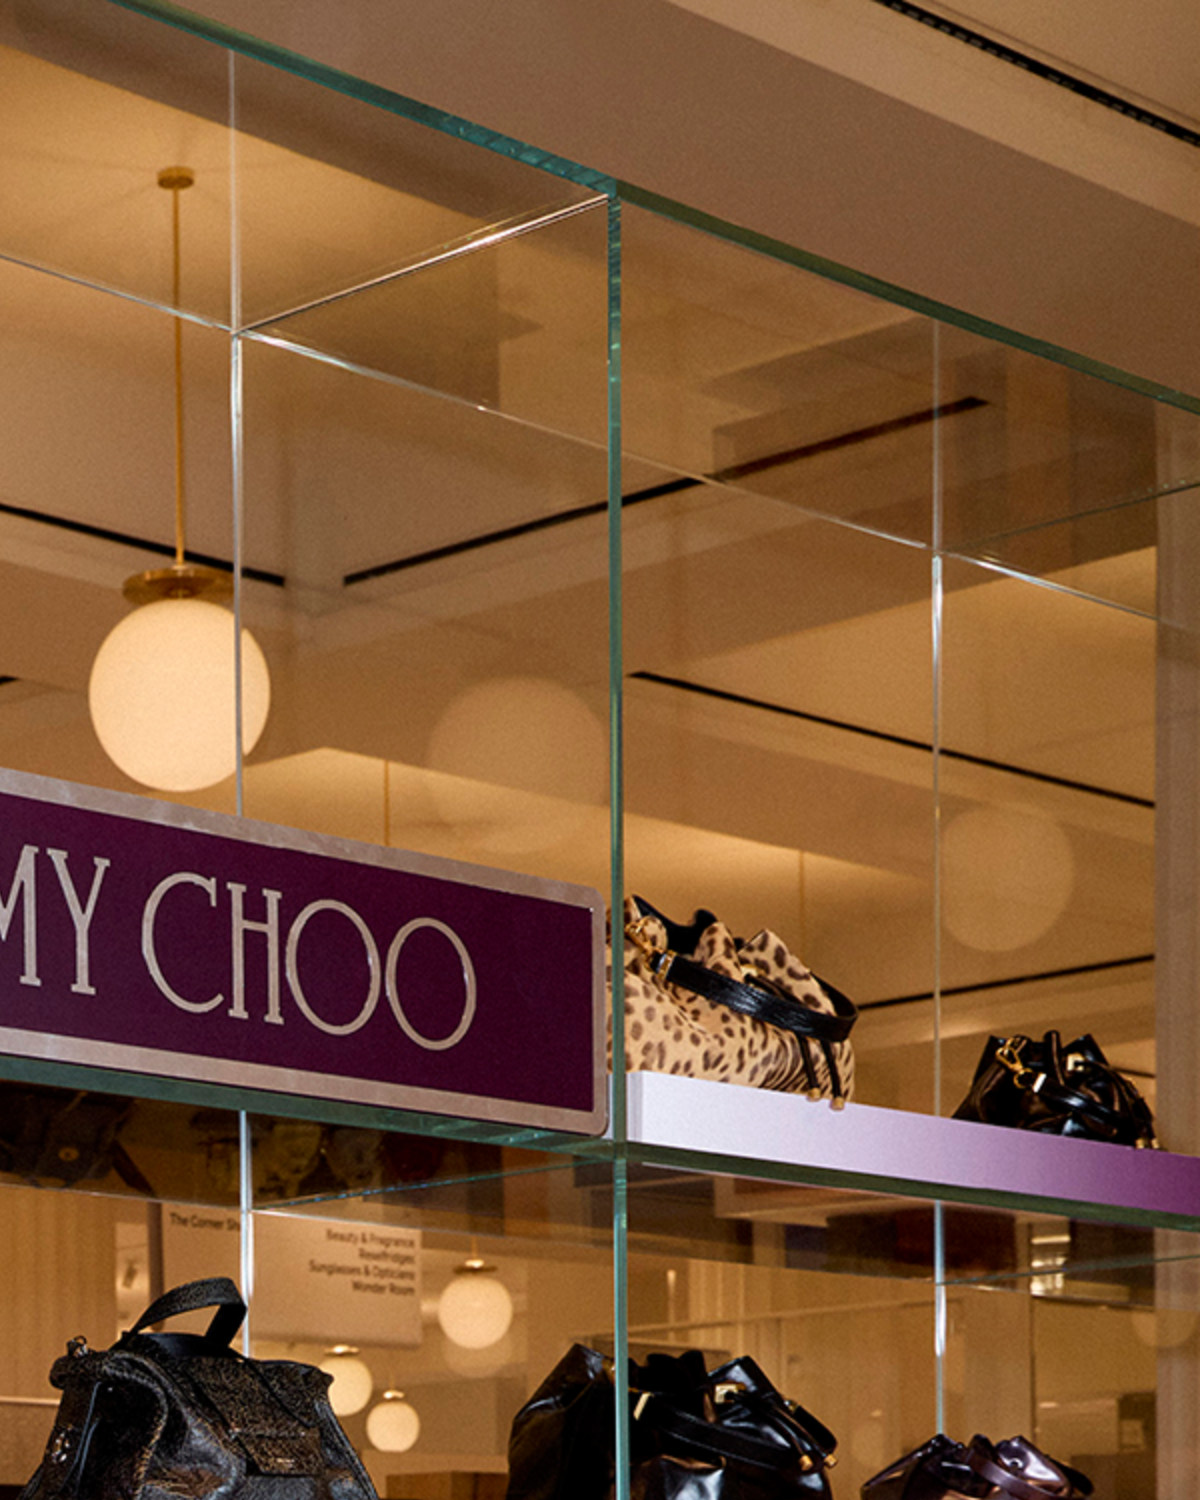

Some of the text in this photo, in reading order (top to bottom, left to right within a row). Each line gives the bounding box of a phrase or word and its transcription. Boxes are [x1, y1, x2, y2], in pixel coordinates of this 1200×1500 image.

[141, 871, 477, 1051] CHOO
[169, 1212, 188, 1226] The
[191, 1214, 224, 1229] Corner
[326, 1229, 414, 1247] Beauty & Fragrance
[309, 1259, 415, 1280] Sunglasses & Opticians
[352, 1280, 415, 1295] Wonder Room
